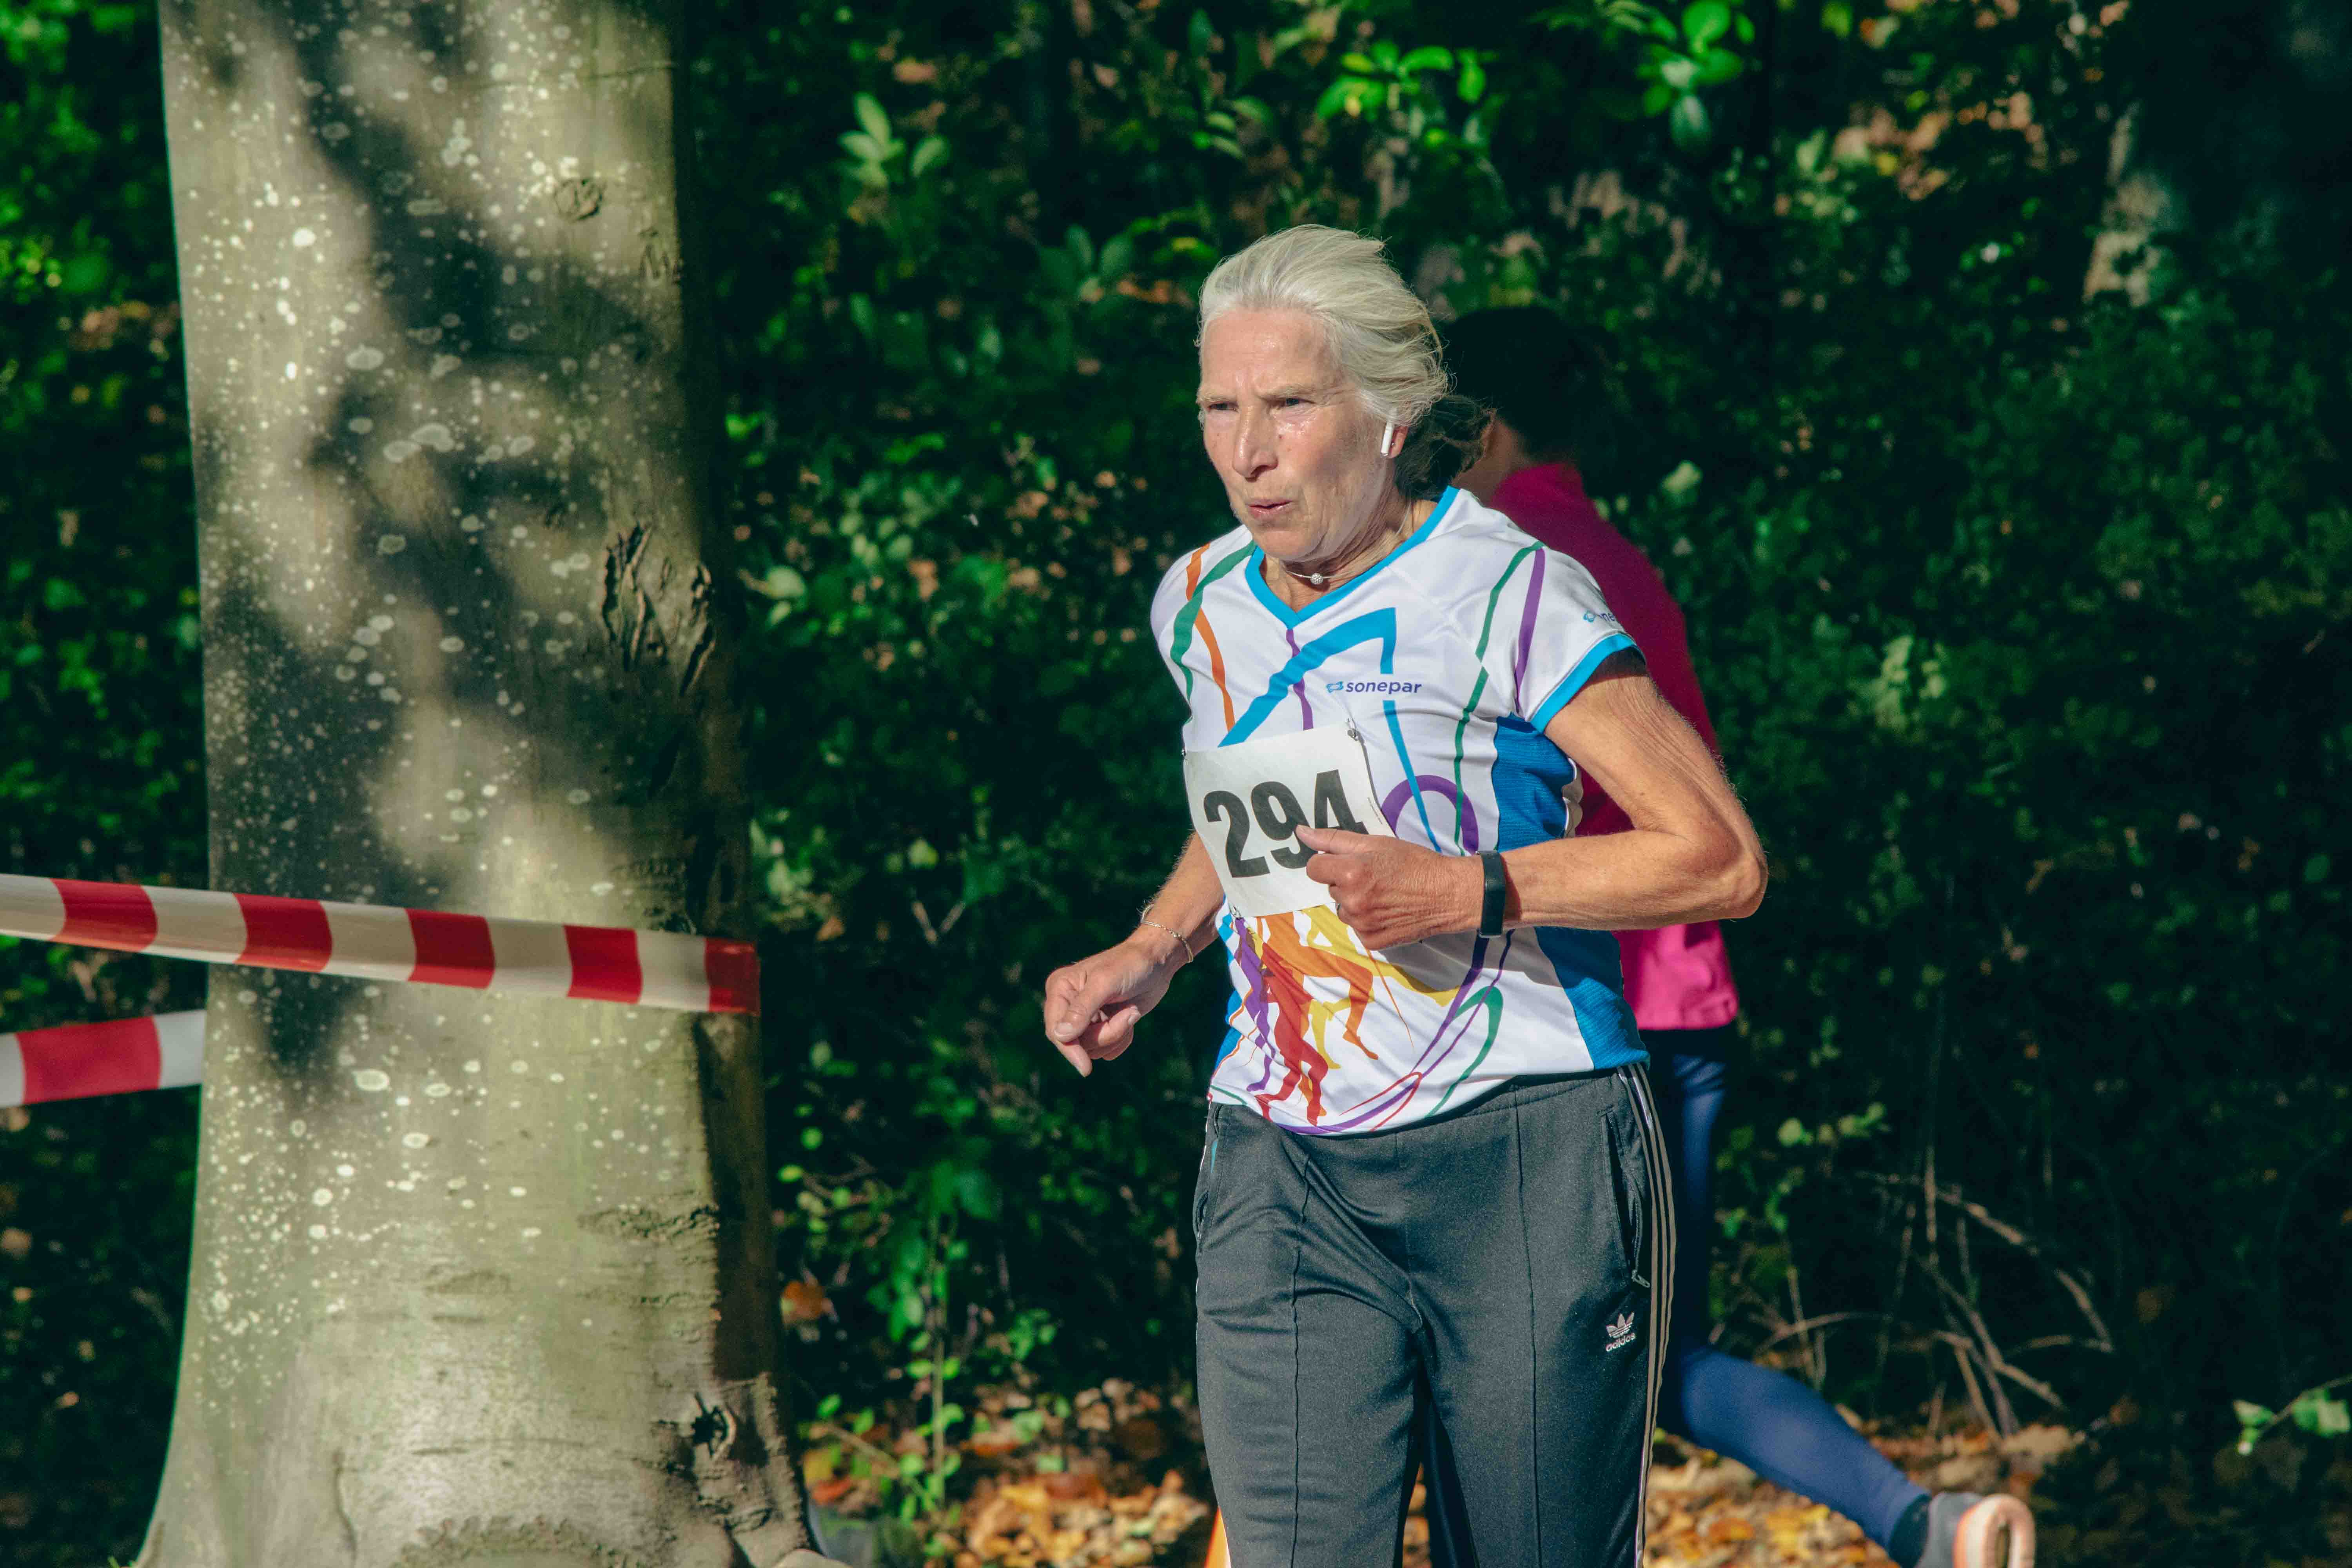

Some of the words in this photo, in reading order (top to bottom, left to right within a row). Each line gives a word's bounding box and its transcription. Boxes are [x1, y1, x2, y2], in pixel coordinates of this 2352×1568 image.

[1345, 681, 1422, 694] sonepar
[1203, 769, 1369, 878] 294
[1606, 1333, 1635, 1352] adidas
